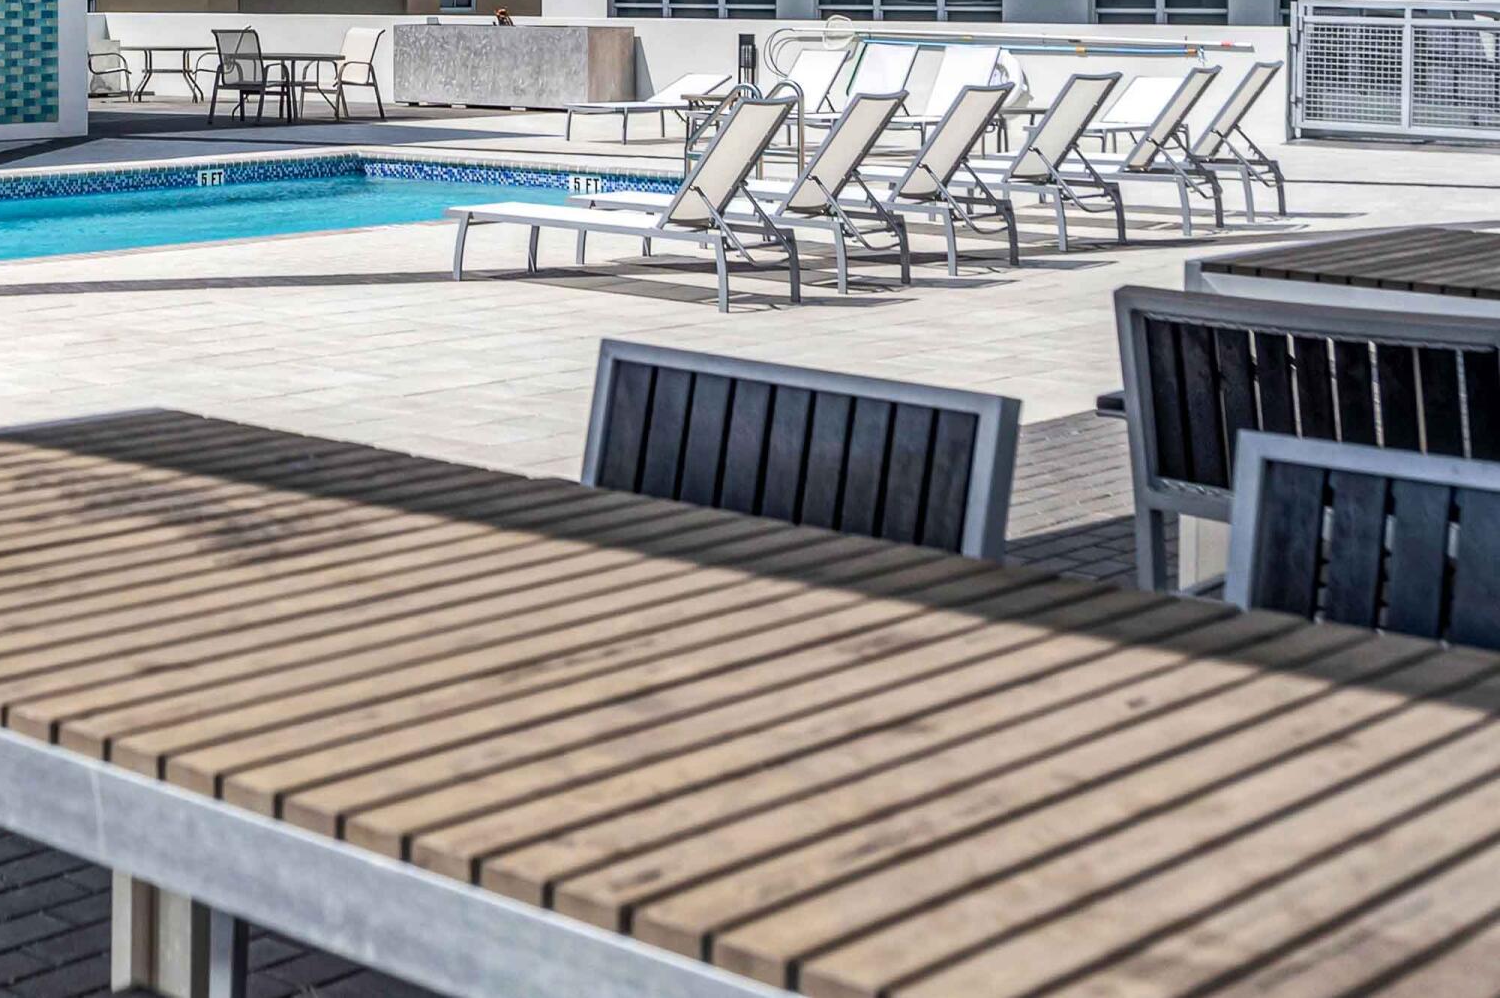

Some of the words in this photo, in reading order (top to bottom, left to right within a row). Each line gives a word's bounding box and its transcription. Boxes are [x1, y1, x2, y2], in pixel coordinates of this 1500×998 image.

[211, 171, 223, 186] FT
[574, 177, 581, 193] 5
[586, 177, 600, 194] FT
